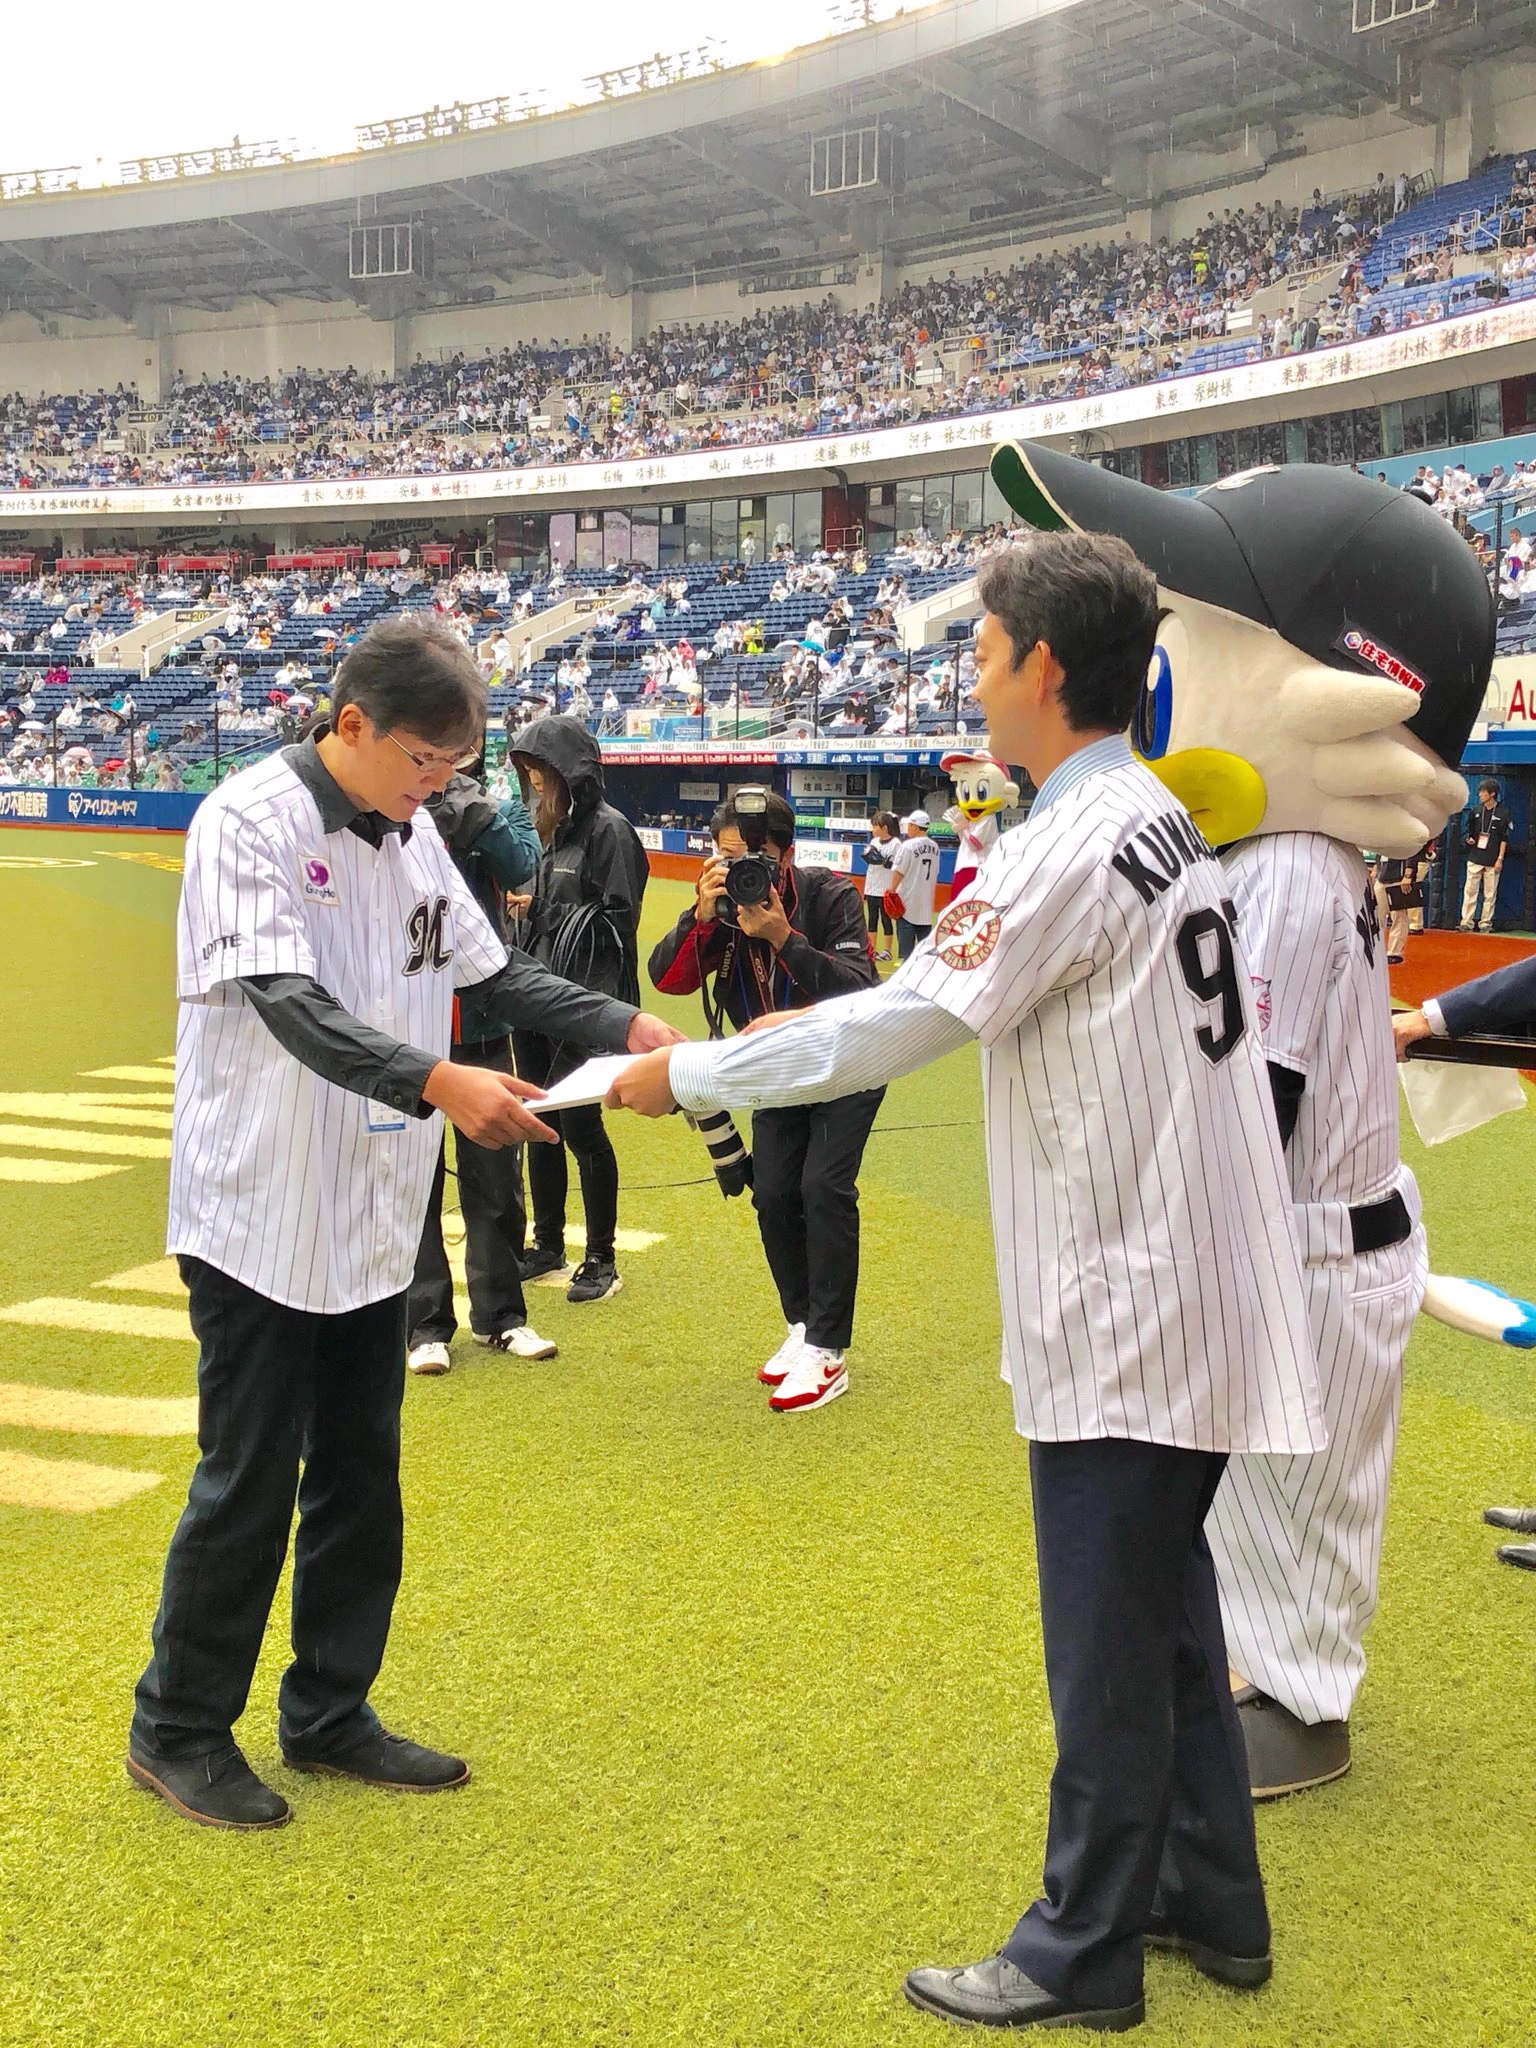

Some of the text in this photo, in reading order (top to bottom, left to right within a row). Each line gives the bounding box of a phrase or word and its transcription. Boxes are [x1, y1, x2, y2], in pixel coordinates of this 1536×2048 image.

[1403, 335, 1428, 360] 小林
[688, 835, 704, 851] Jeep
[922, 858, 931, 881] 7
[202, 933, 242, 960] LOTTE
[720, 942, 735, 978] Canon
